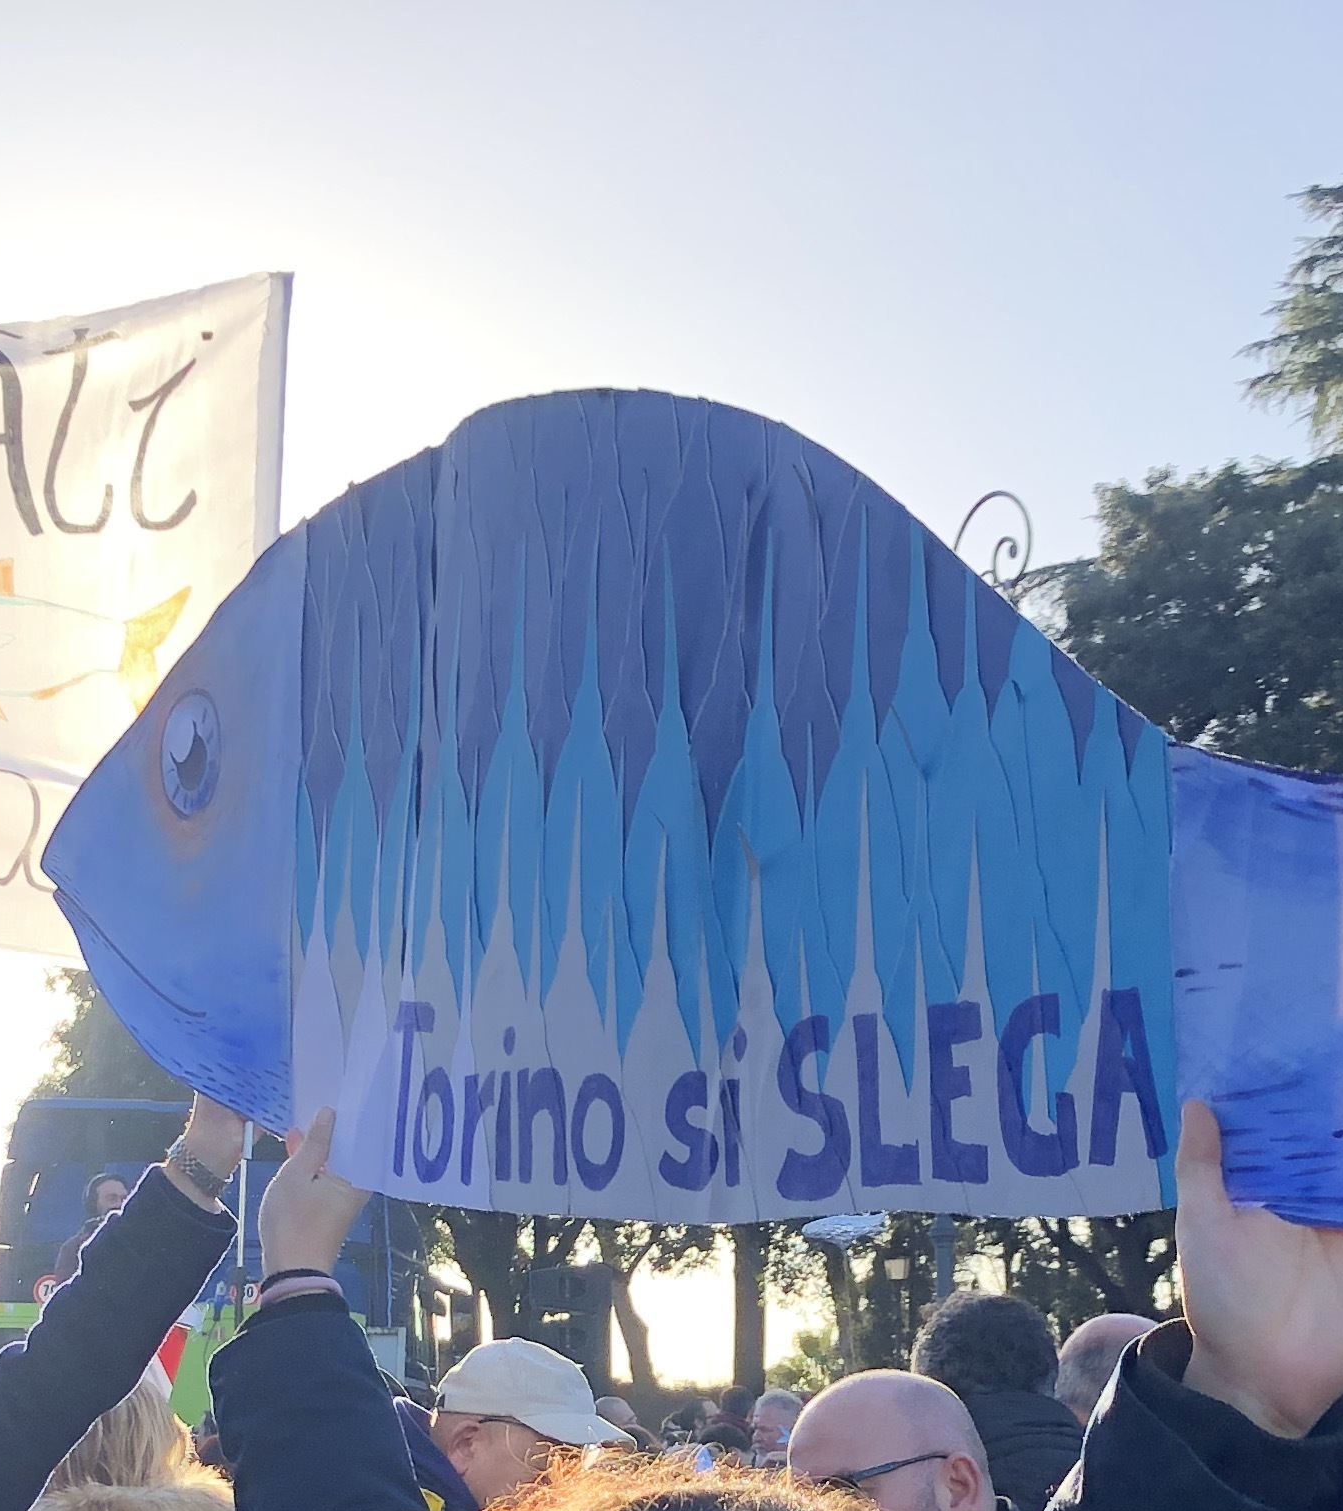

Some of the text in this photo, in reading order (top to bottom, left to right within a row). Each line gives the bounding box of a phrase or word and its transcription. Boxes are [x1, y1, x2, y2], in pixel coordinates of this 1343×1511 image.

[394, 988, 1168, 1200] Torino si SLEGA
